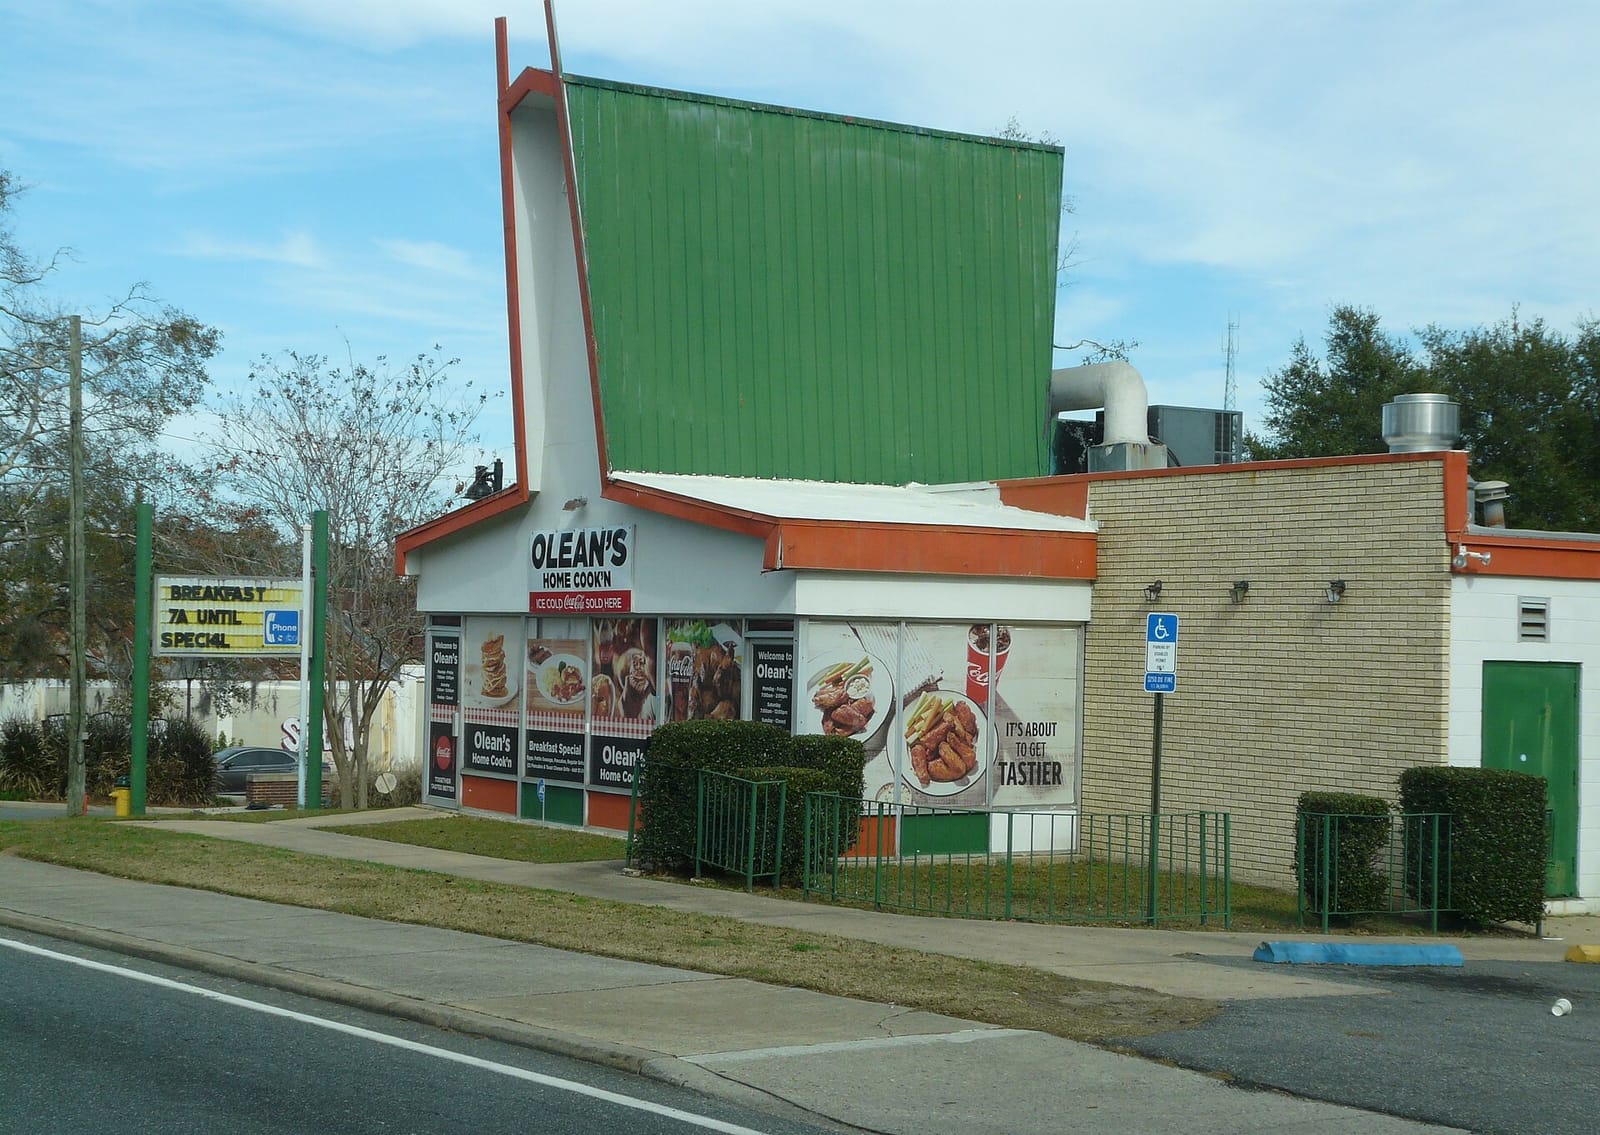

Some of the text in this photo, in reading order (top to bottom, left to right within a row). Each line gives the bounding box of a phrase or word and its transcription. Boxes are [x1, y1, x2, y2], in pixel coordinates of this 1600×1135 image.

[531, 528, 628, 569] OLEAN'S
[543, 570, 612, 589] HOME COOK'N
[170, 585, 266, 602] BREAKFAST
[536, 598, 546, 608] ICE
[546, 598, 563, 609] COLD
[585, 598, 604, 608] SOLD
[604, 597, 622, 608] HERE
[168, 608, 242, 625] 7A UNTIL
[272, 623, 297, 632] Phone
[433, 651, 458, 665] Olean's
[758, 651, 792, 661] Welcome to
[756, 663, 793, 679] Olean's
[1006, 722, 1057, 737] IT'S ABOUT
[474, 730, 511, 753] Olean's
[529, 740, 582, 757] Breakfast Special
[1016, 742, 1046, 757] TO GET
[472, 752, 490, 767] Home
[491, 755, 513, 769] Cook'n
[600, 768, 621, 782] Home
[999, 761, 1062, 786] TASTIER
